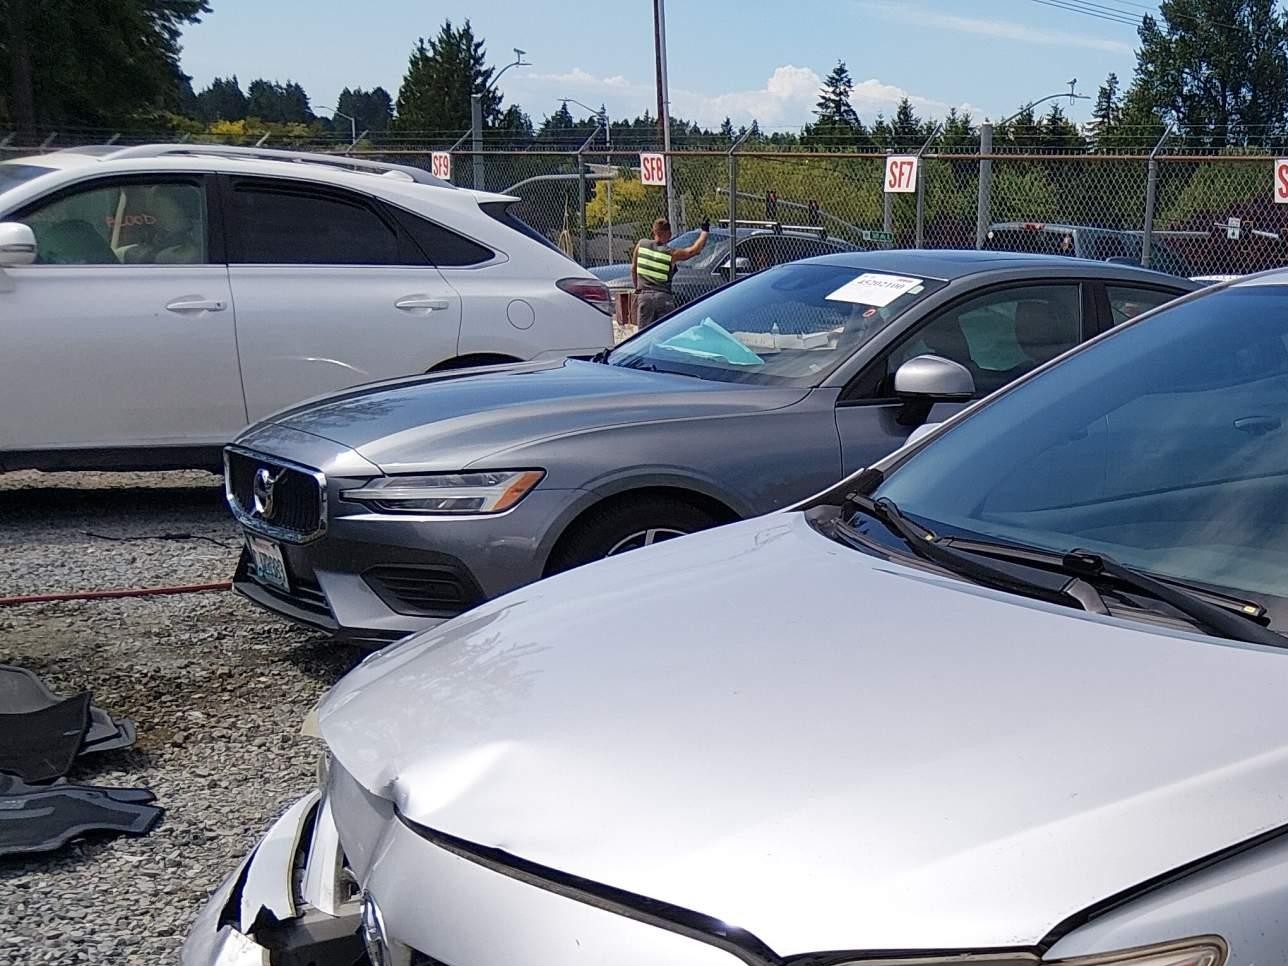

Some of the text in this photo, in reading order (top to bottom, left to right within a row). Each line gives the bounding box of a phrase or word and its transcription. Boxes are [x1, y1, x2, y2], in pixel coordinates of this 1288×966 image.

[433, 155, 449, 176] SF9
[643, 156, 663, 181] SF8
[889, 160, 914, 188] SF7
